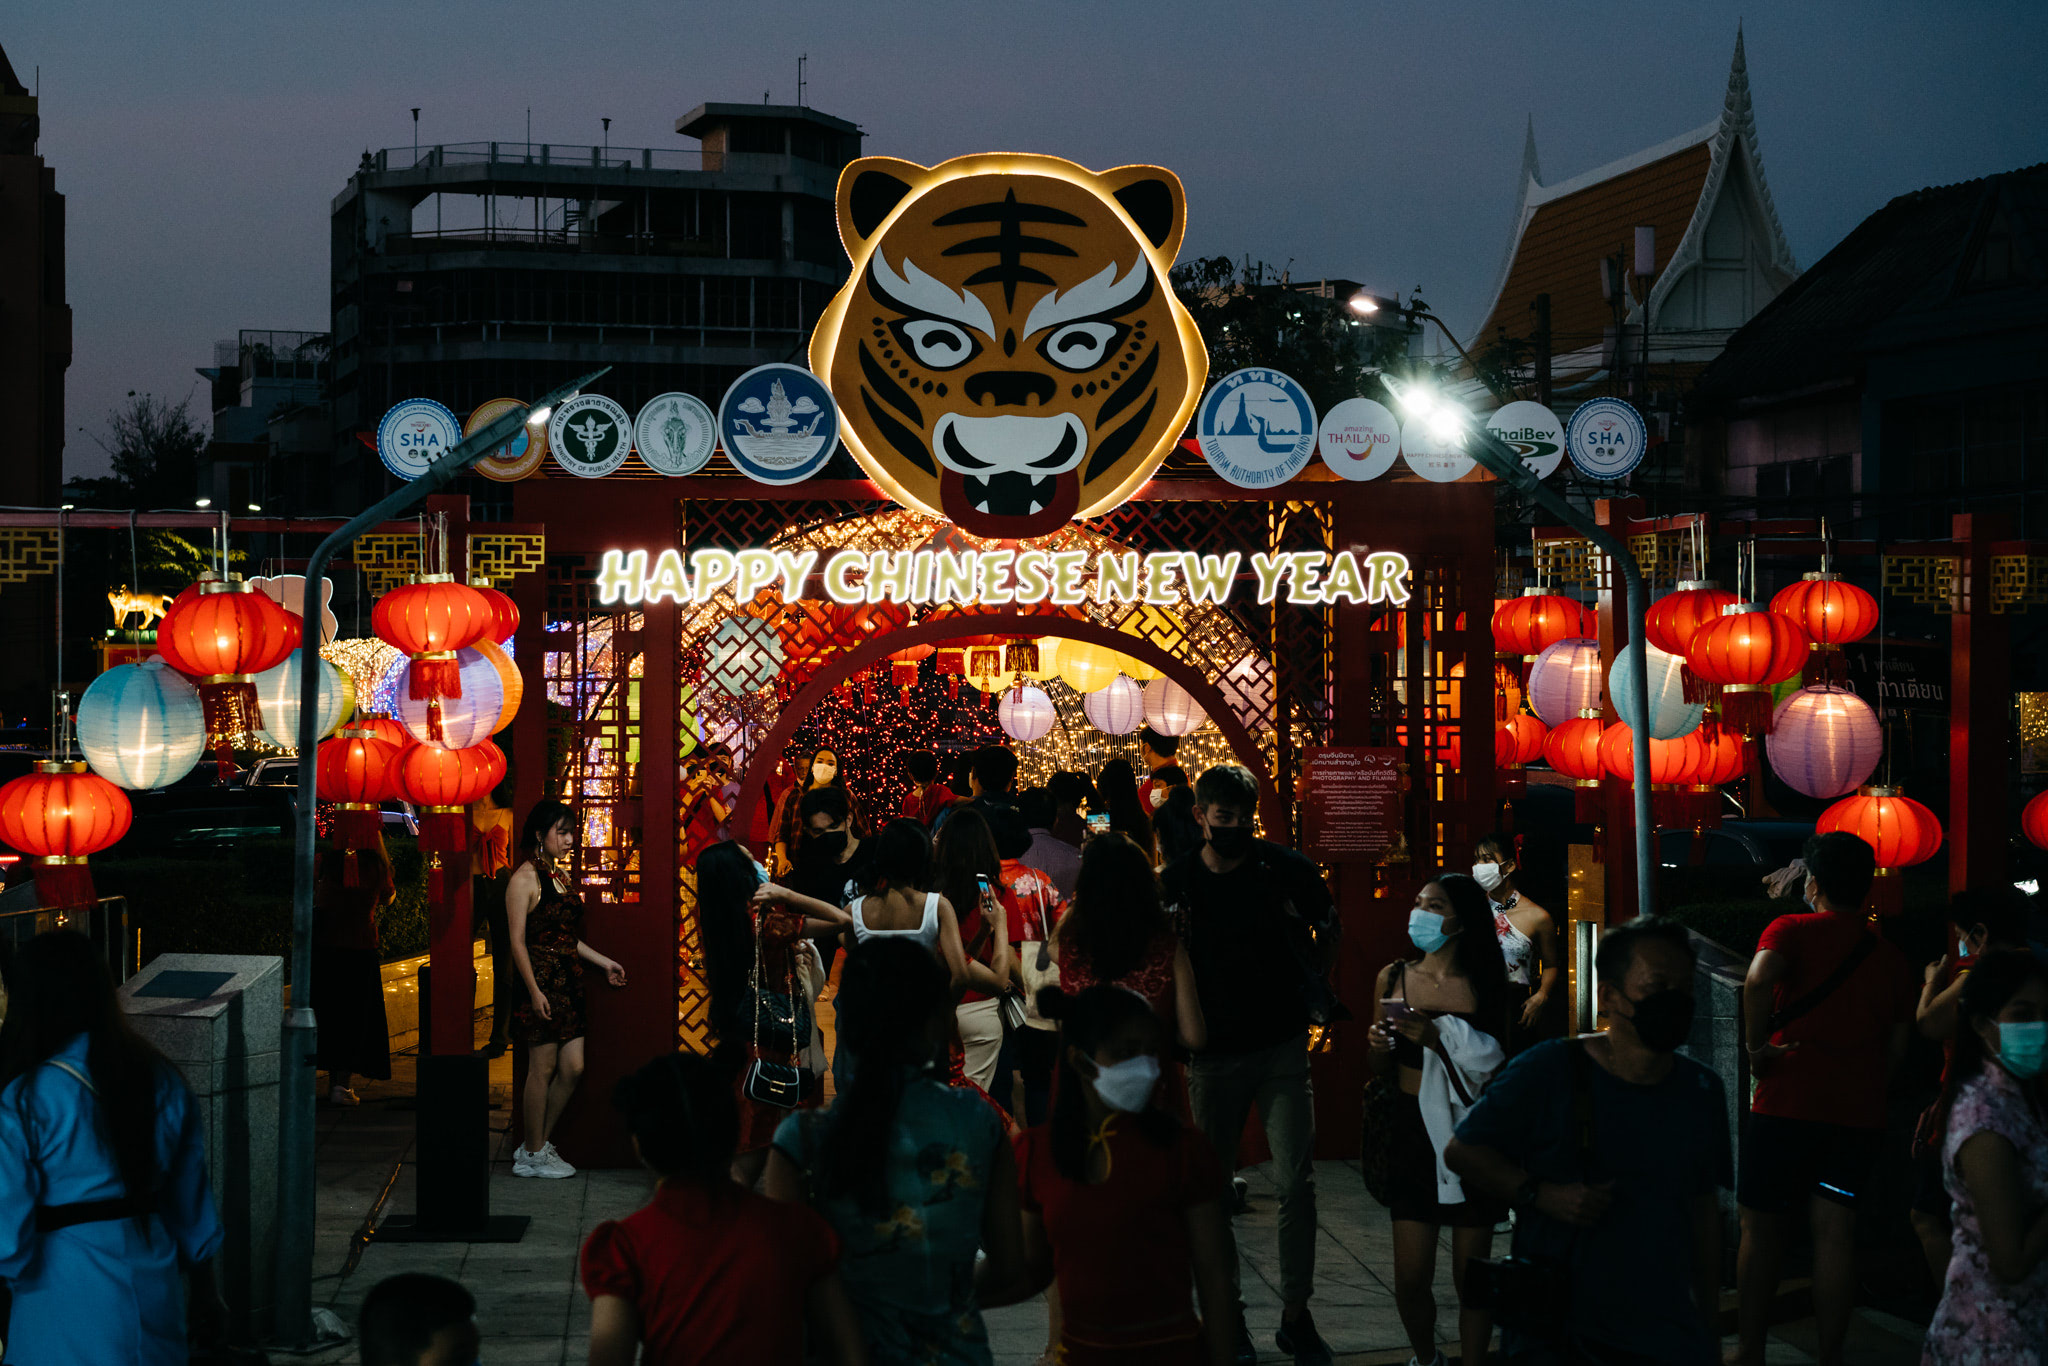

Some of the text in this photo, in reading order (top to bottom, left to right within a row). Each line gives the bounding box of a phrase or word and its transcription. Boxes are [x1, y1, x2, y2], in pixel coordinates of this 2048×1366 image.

[1343, 425, 1374, 434] amazing
[1486, 427, 1556, 440] ThaiBev
[400, 433, 440, 446] SHA
[1327, 433, 1390, 444] THAILAND
[1588, 431, 1625, 445] SHA
[555, 443, 577, 468] MINISTRY
[588, 462, 612, 473] PUBLIC
[611, 441, 627, 464] HEALTH
[1205, 435, 1311, 484] TOURISM AUTHORITY OF THAILAND
[597, 549, 1411, 605] HAPPY CHINESE NEW YEAR
[1876, 674, 1944, 701] ท่าเตียน
